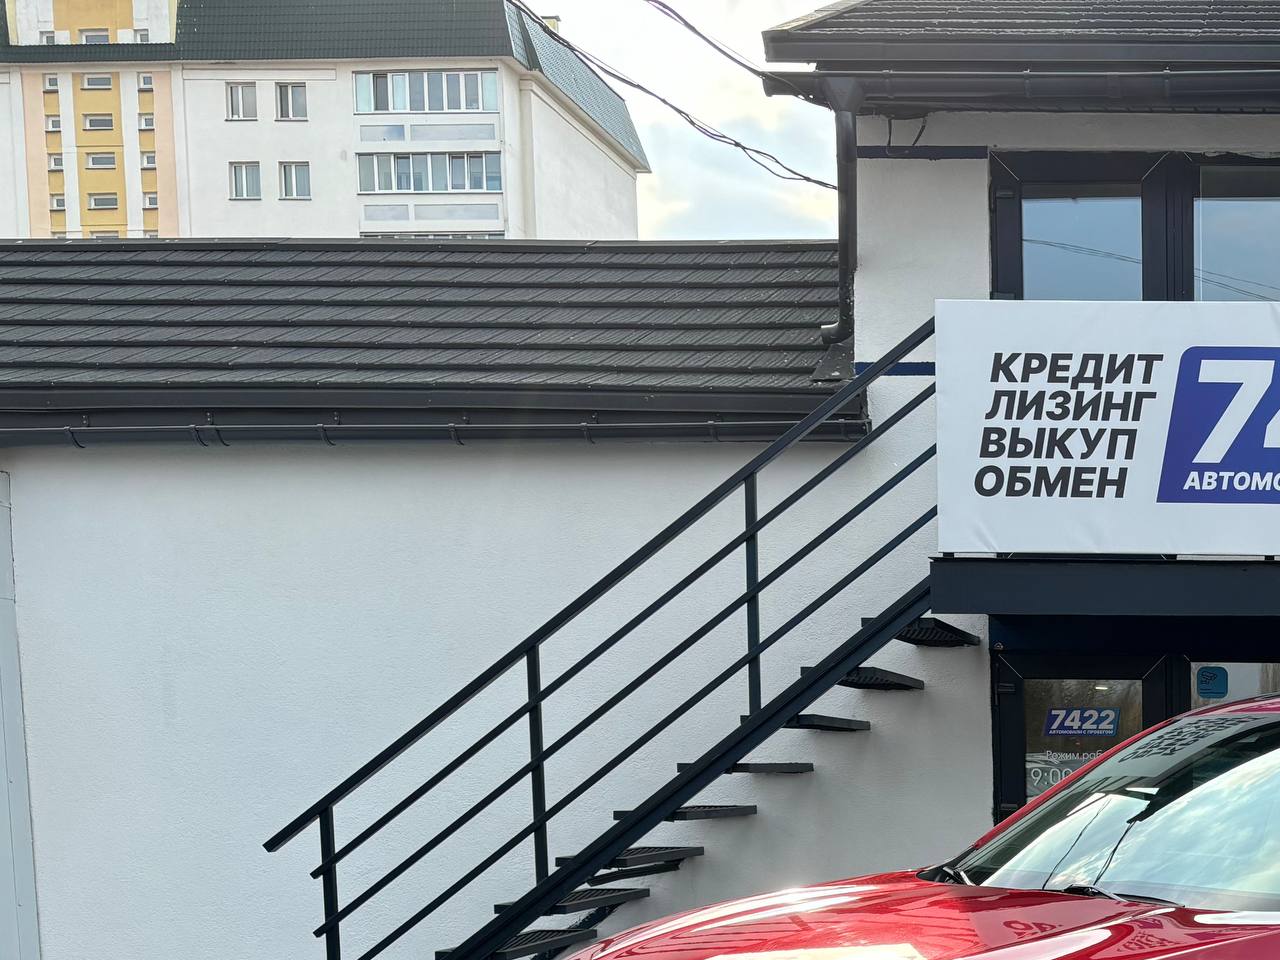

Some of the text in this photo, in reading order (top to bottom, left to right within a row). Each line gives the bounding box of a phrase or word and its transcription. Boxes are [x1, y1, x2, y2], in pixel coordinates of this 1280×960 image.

[990, 352, 1164, 391] КРЕДИТ
[984, 389, 1158, 422] ЛИЗИНГ
[979, 427, 1138, 460] ВЫКУП
[974, 465, 1129, 499] ОБМЕН
[1050, 709, 1116, 730] 7422
